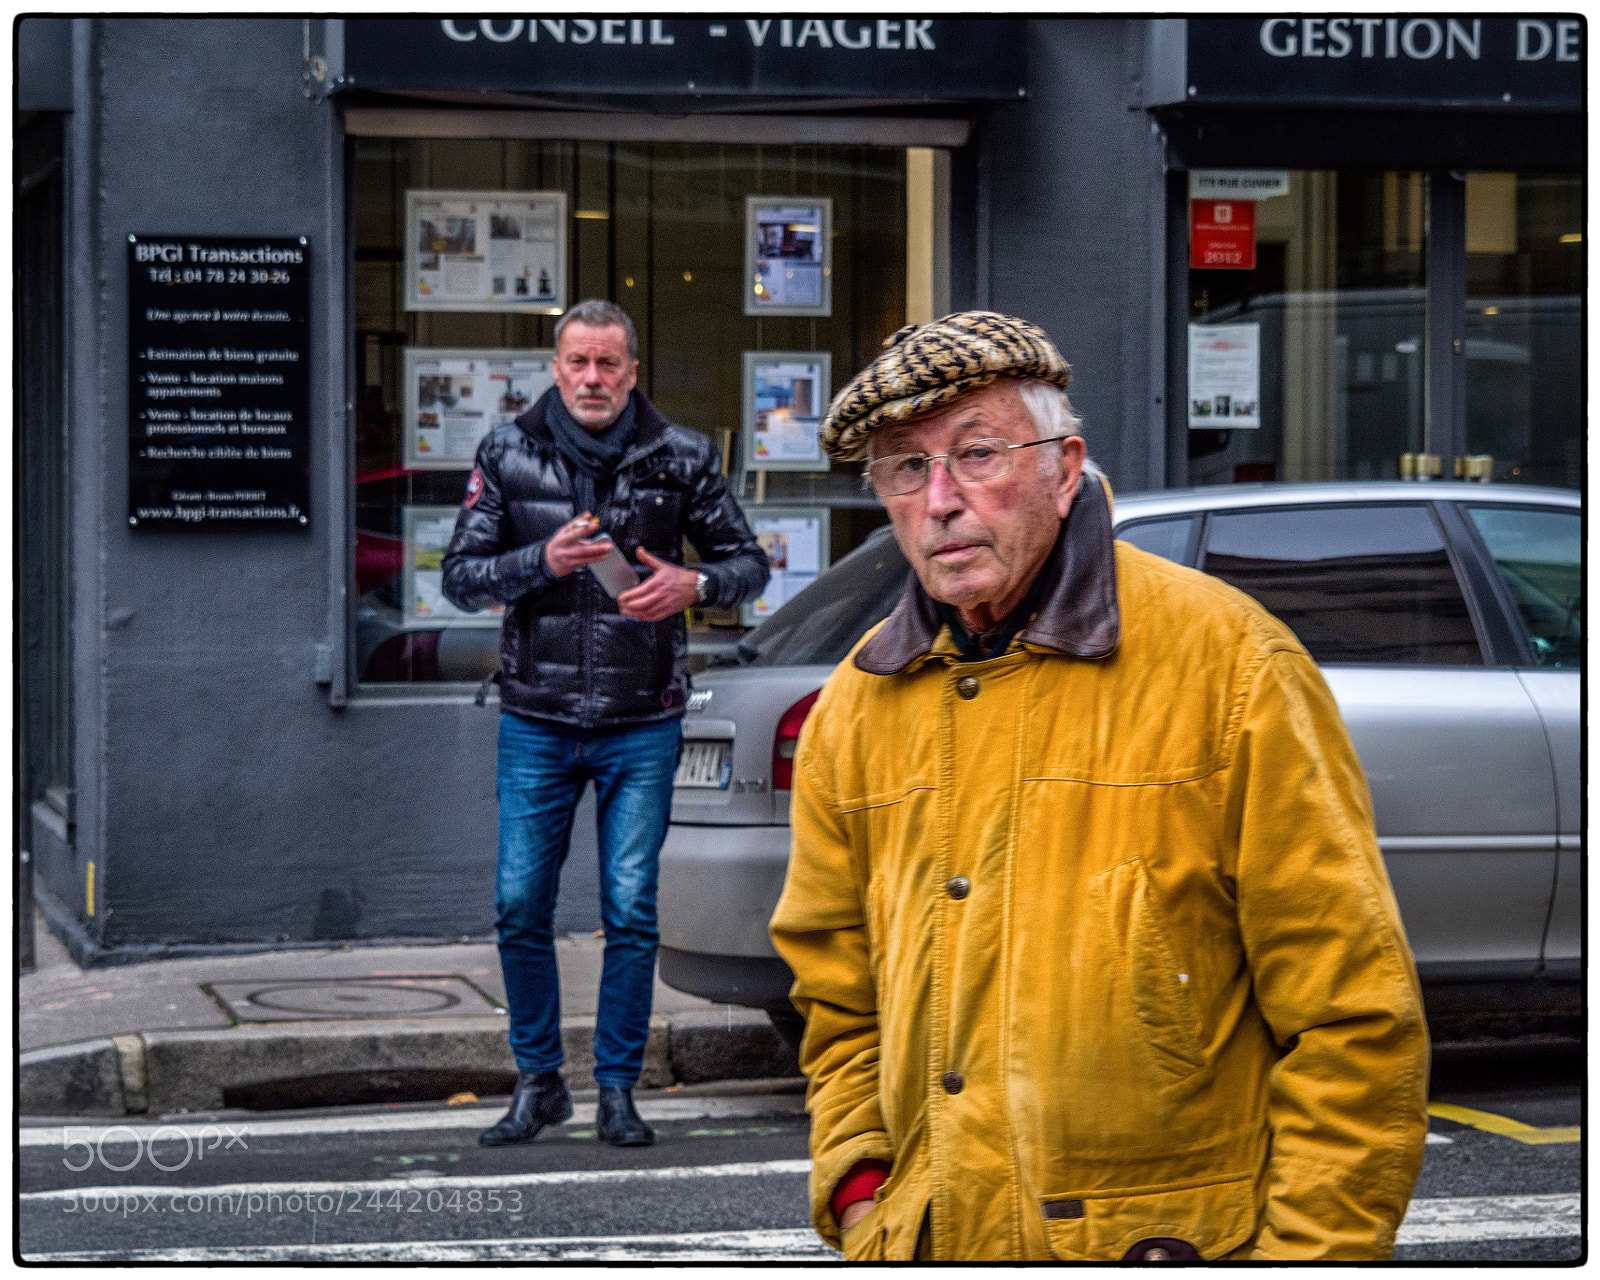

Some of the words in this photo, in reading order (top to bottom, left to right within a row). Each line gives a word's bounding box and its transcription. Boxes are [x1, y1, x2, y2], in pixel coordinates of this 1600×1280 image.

[440, 19, 675, 46] CONSEIL
[744, 19, 936, 50] VIAGER
[1259, 19, 1482, 60] GESTION
[1516, 20, 1580, 62] DE
[135, 243, 183, 263] BPGI
[188, 244, 304, 264] Transactions
[1204, 252, 1242, 264] 2012
[183, 269, 202, 283] 04
[206, 269, 225, 283] 78
[228, 269, 247, 283] 24
[250, 269, 268, 284] 30
[271, 270, 290, 284] 26
[172, 311, 211, 324] agence
[222, 311, 250, 322] votre
[147, 348, 206, 361] Estimation
[207, 348, 222, 361] de
[224, 348, 255, 361] biens
[256, 350, 299, 364] gratuite
[147, 371, 181, 384] Vente
[190, 371, 237, 384] location
[238, 372, 284, 385] maisons
[147, 386, 222, 399] appartements
[147, 408, 182, 420] Vente
[190, 408, 237, 421] location
[239, 408, 254, 421] de
[255, 408, 293, 421] locaux
[147, 423, 227, 437] professionnels
[228, 424, 240, 434] et
[241, 423, 287, 435] bureaux
[147, 446, 206, 459] Recherche
[245, 446, 260, 459] de
[261, 446, 292, 459] biens
[137, 504, 300, 522] www.bpgi-transactions.fr
